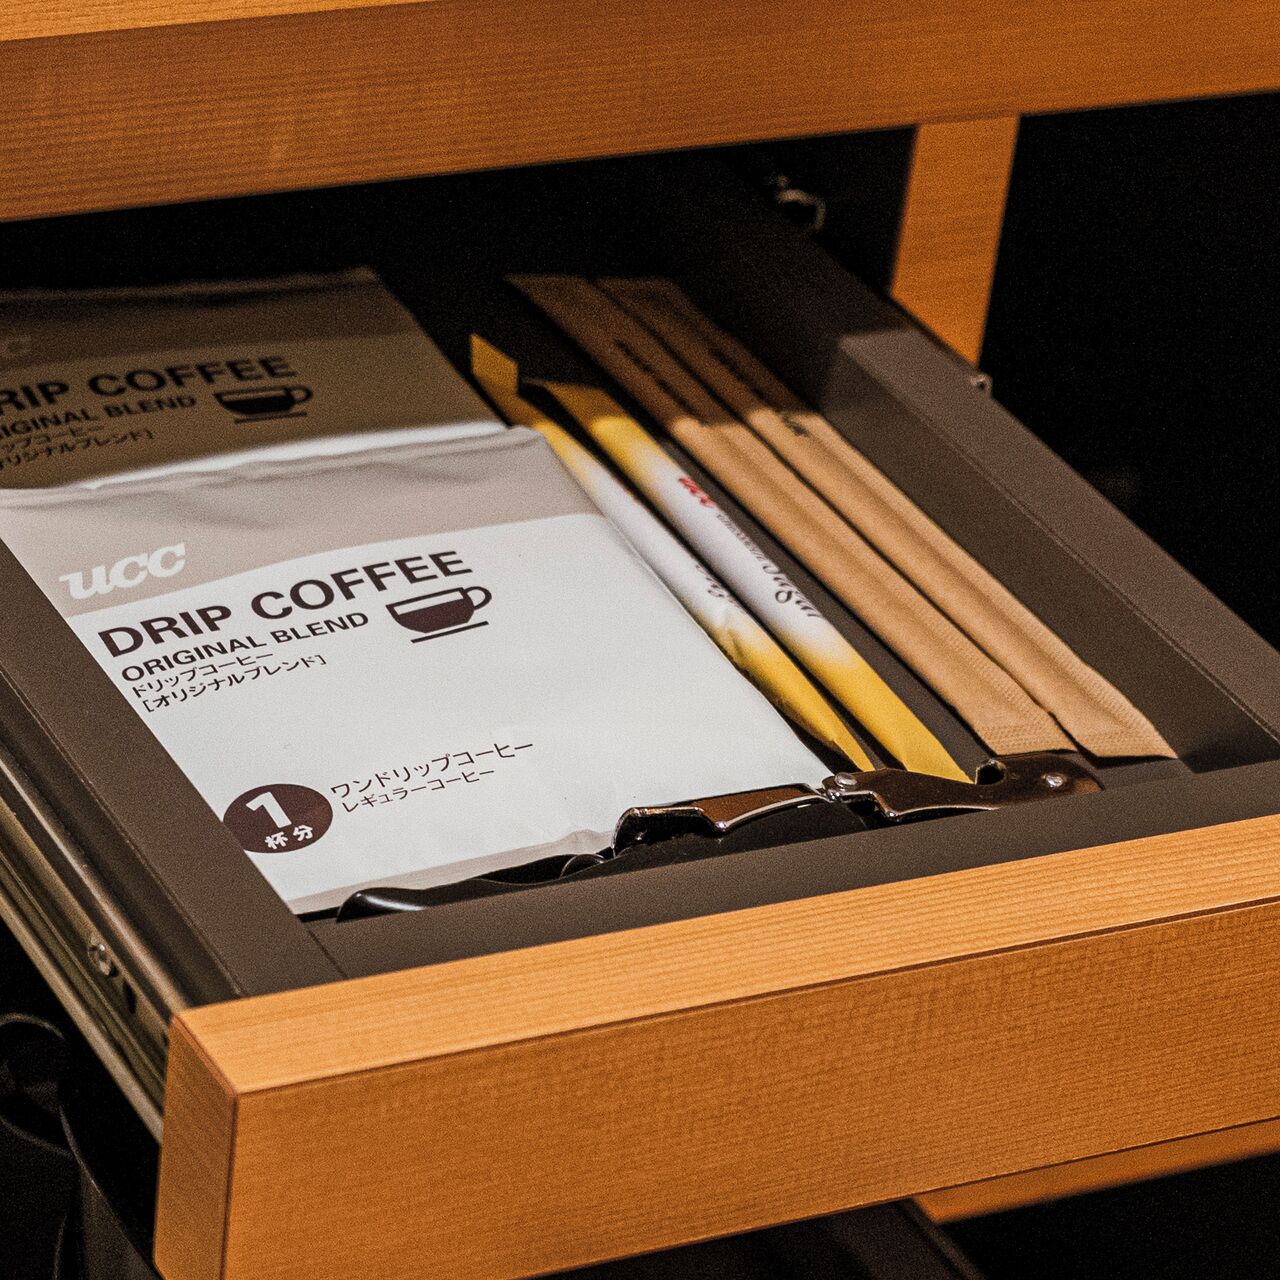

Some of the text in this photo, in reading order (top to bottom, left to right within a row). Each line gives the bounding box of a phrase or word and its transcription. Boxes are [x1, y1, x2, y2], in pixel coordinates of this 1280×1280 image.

[86, 355, 297, 397] COFFEE
[102, 394, 197, 419] BLEND
[97, 551, 473, 659] DRIP COFFEE
[121, 612, 370, 683] ORIGINAL BLEND
[131, 652, 275, 698] ドリップコーヒー
[329, 742, 534, 799] ワンドリップコーヒー
[341, 769, 496, 814] レギュラーコーヒー
[245, 790, 293, 829] 1
[264, 823, 314, 850] 杯分
